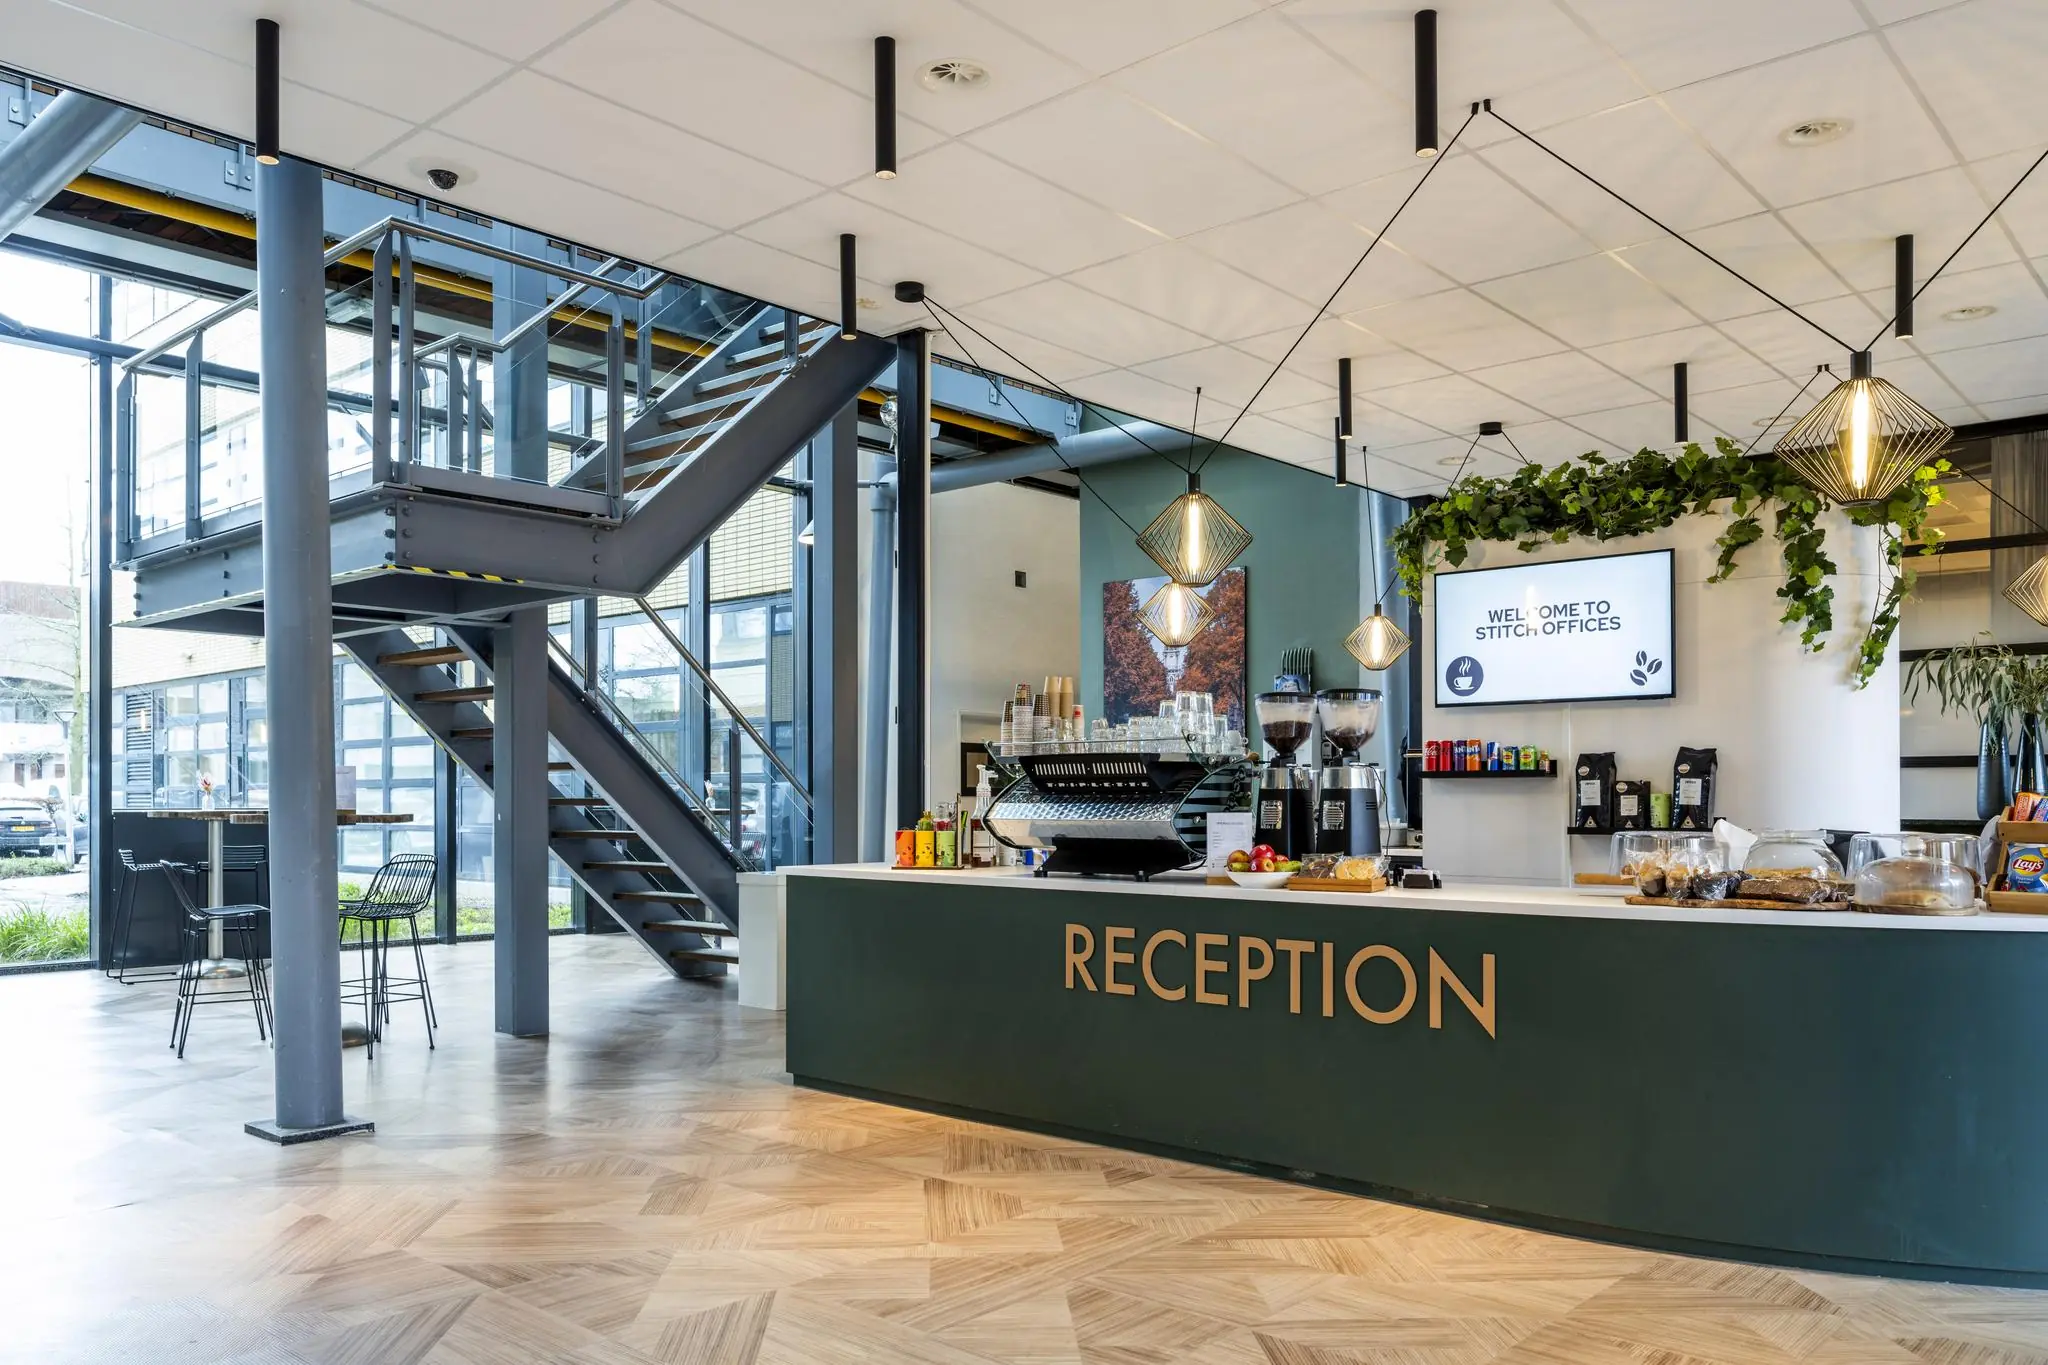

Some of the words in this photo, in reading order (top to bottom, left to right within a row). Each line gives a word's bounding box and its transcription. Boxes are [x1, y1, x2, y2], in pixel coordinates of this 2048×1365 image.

[1488, 602, 1580, 623] WELOME
[1584, 600, 1610, 615] TO
[1476, 623, 1537, 640] STITCH
[1542, 616, 1621, 635] OFFICES
[2014, 858, 2043, 872] Lay's
[1065, 923, 1496, 1041] RECEPTION
